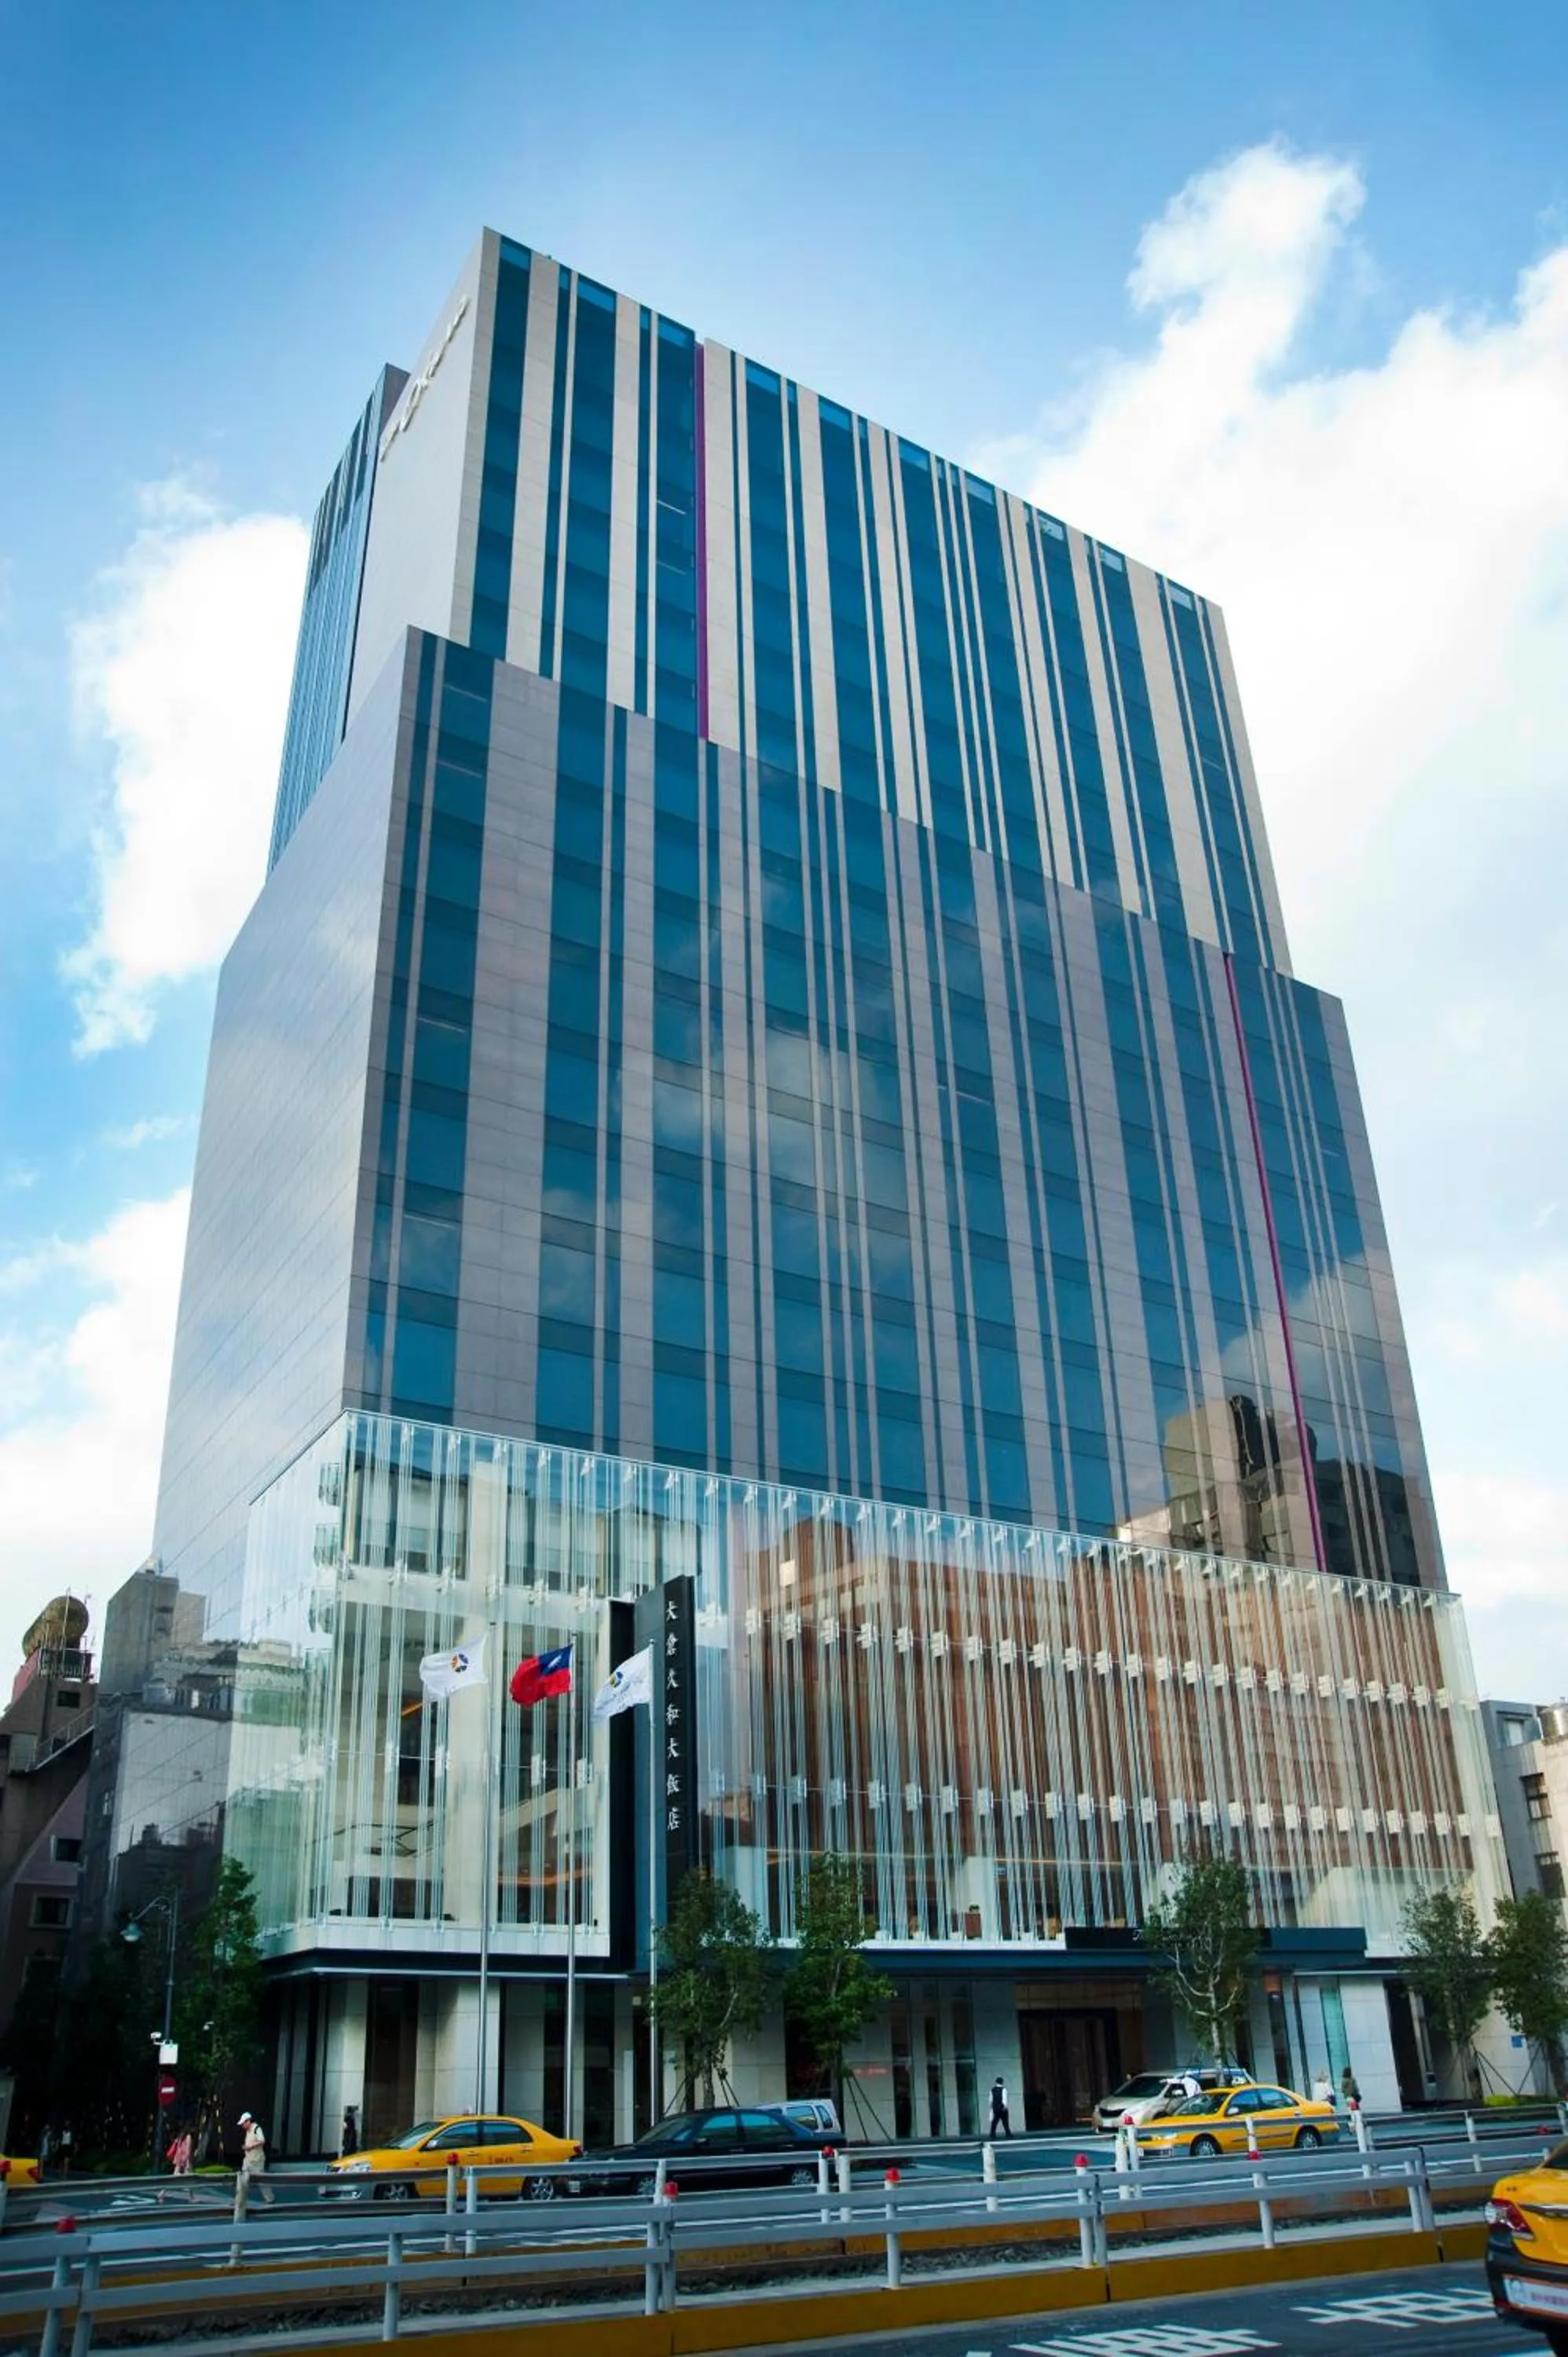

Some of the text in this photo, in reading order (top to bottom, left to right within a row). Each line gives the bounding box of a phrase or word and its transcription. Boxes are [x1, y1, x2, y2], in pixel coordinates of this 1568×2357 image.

[666, 1600, 681, 1831] 大倉久和大飯店
